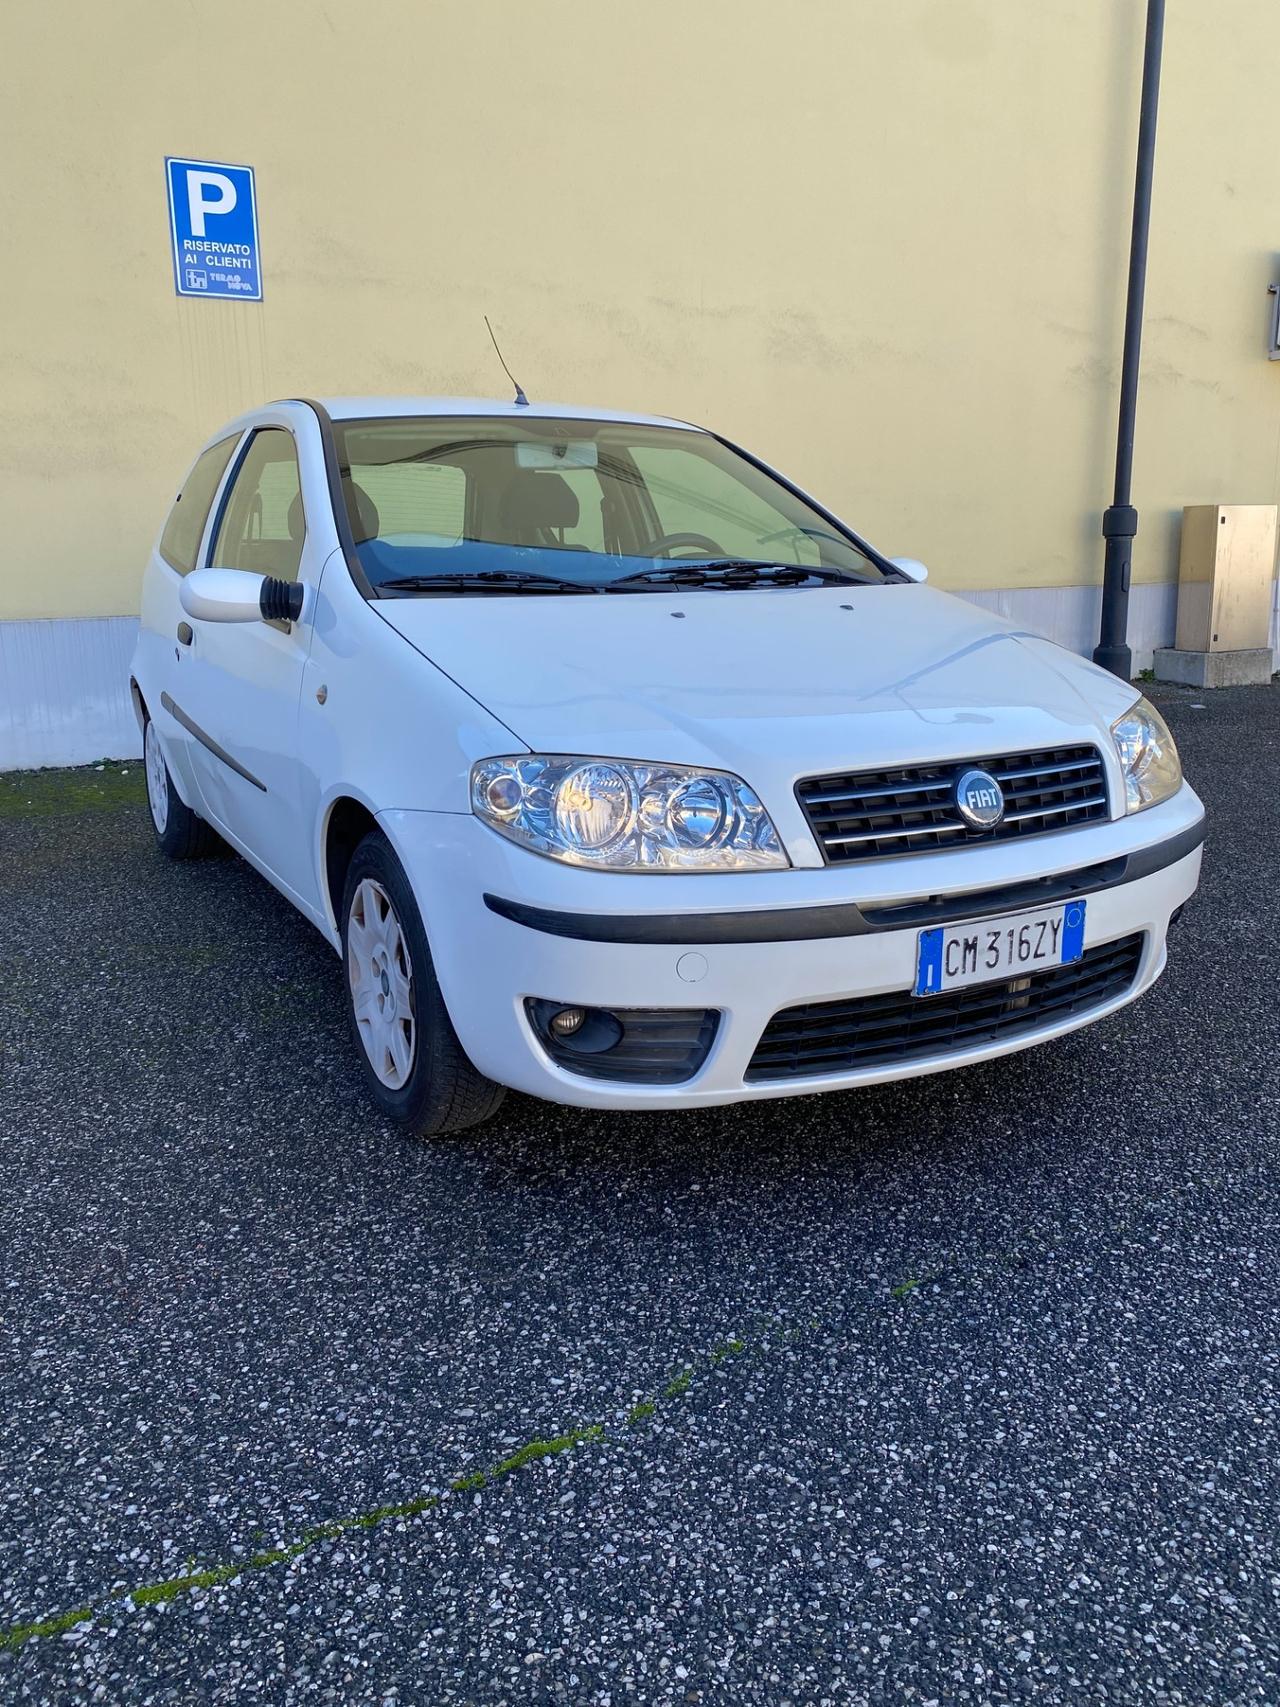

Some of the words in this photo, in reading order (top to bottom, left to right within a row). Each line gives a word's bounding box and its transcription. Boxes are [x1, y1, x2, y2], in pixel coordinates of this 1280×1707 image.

[187, 170, 237, 237] P
[183, 240, 250, 256] RISERVATO
[184, 254, 197, 264] AI
[205, 256, 252, 269] CLIENTI
[966, 788, 997, 809] FIAT
